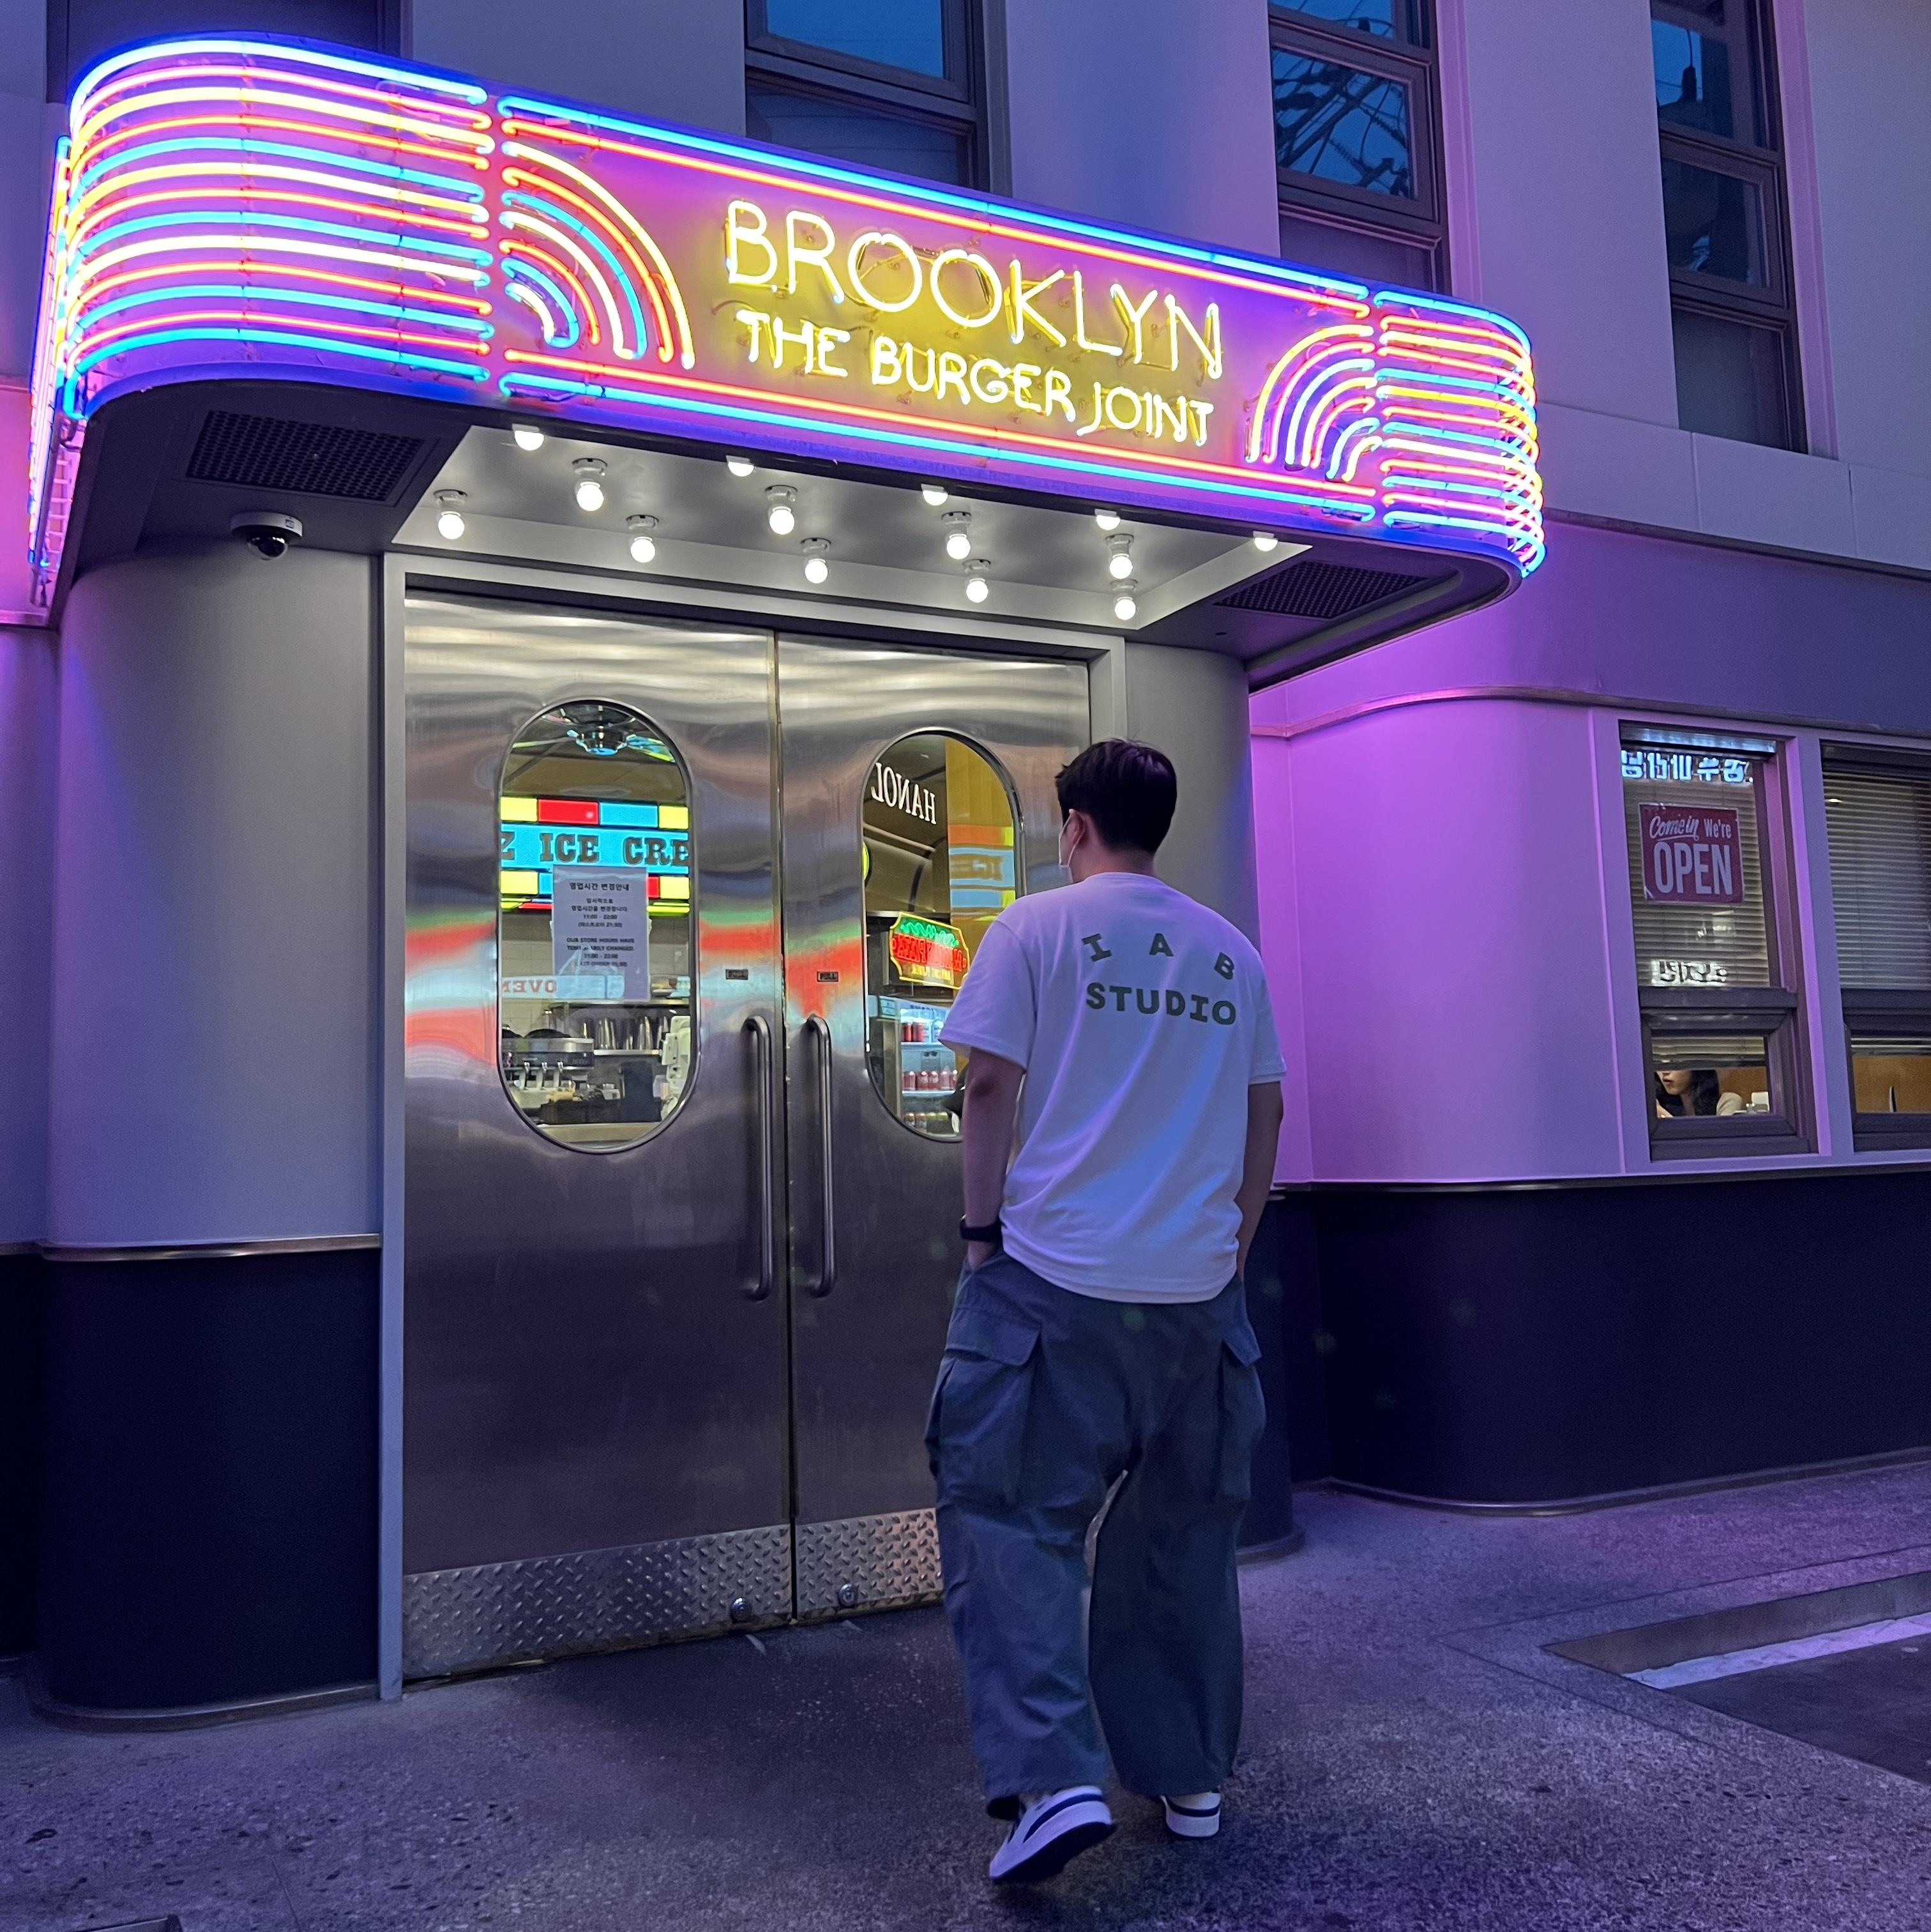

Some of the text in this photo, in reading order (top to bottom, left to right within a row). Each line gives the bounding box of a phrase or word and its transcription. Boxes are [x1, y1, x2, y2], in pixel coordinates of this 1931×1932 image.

[726, 199, 1223, 379] BROOKLYN
[736, 309, 1215, 448] THE BURGER JOINT
[540, 833, 600, 863] ICE
[1704, 818, 1732, 839] We're
[570, 882, 598, 890] 영업시간
[1654, 841, 1733, 895] OPEN
[1086, 982, 1236, 1026] STUDIO
